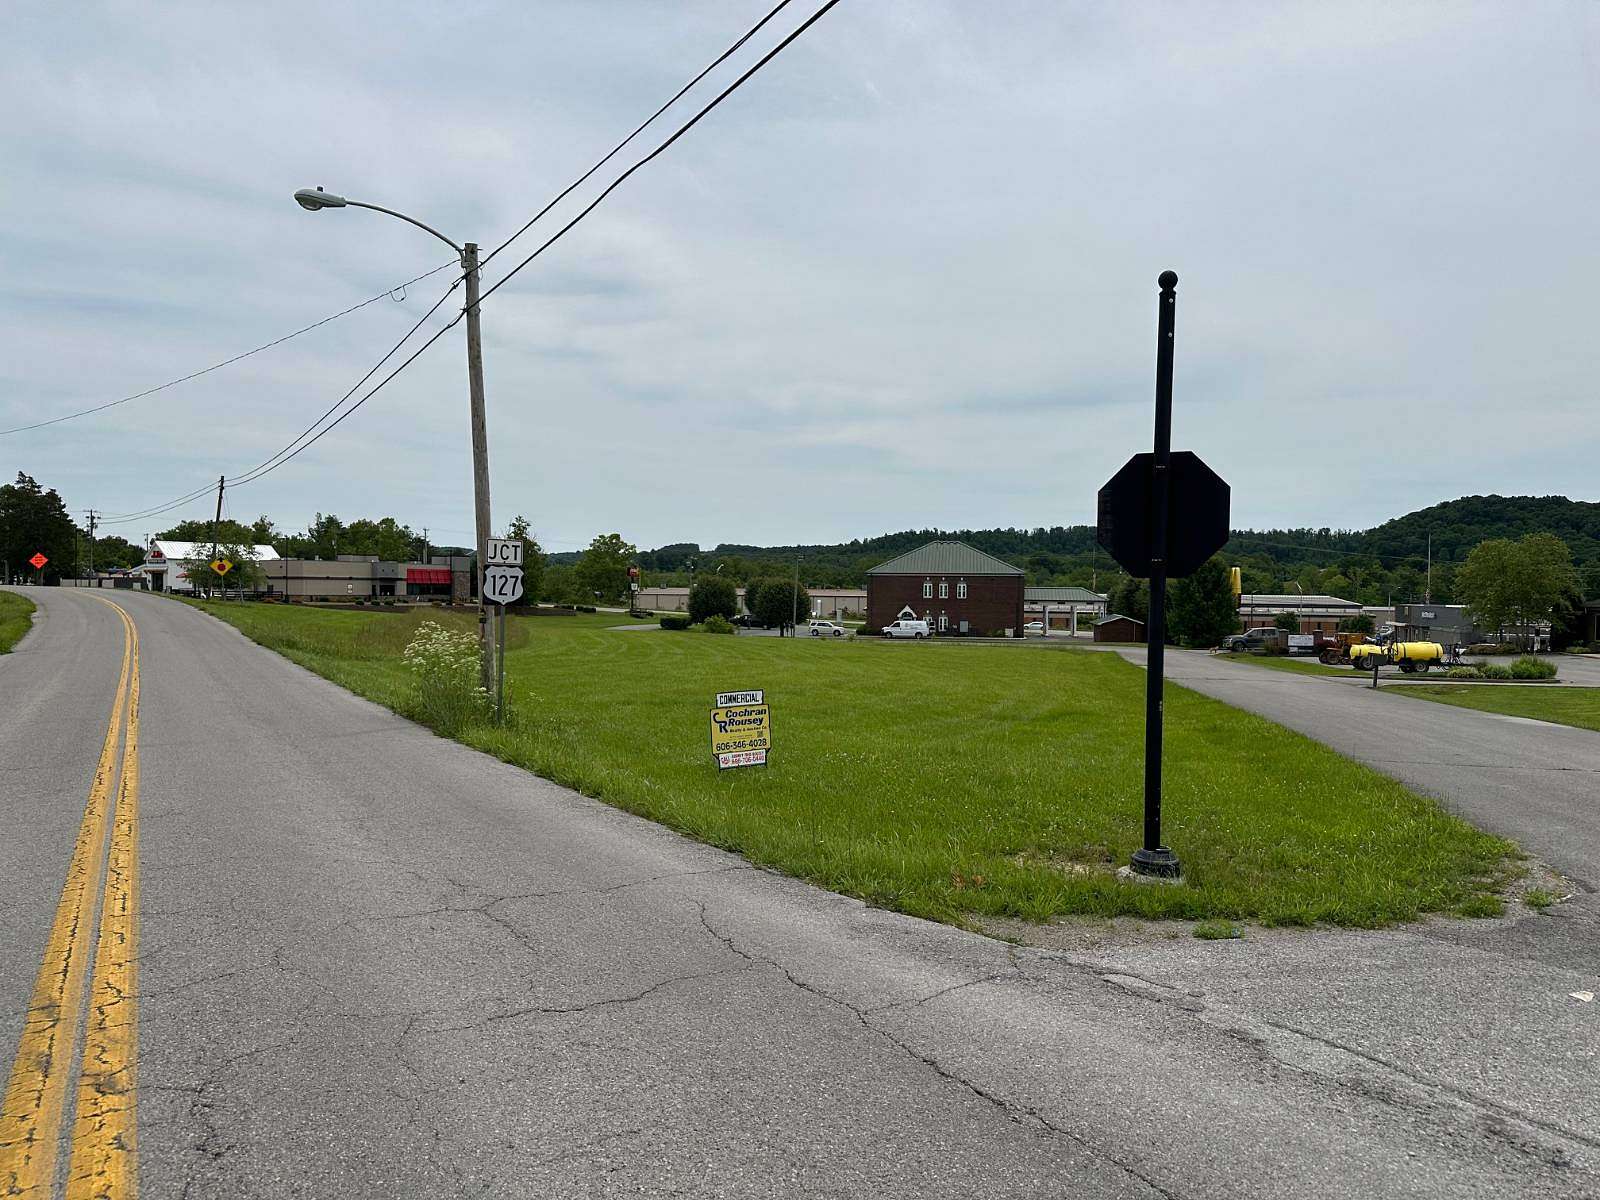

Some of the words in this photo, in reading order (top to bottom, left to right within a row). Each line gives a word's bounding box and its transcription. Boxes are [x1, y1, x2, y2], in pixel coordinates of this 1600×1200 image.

[488, 544, 520, 561] JCT
[491, 574, 519, 596] 127
[719, 693, 759, 704] COMMERCIAL
[725, 708, 767, 718] Cochran
[728, 717, 764, 726] Rousey
